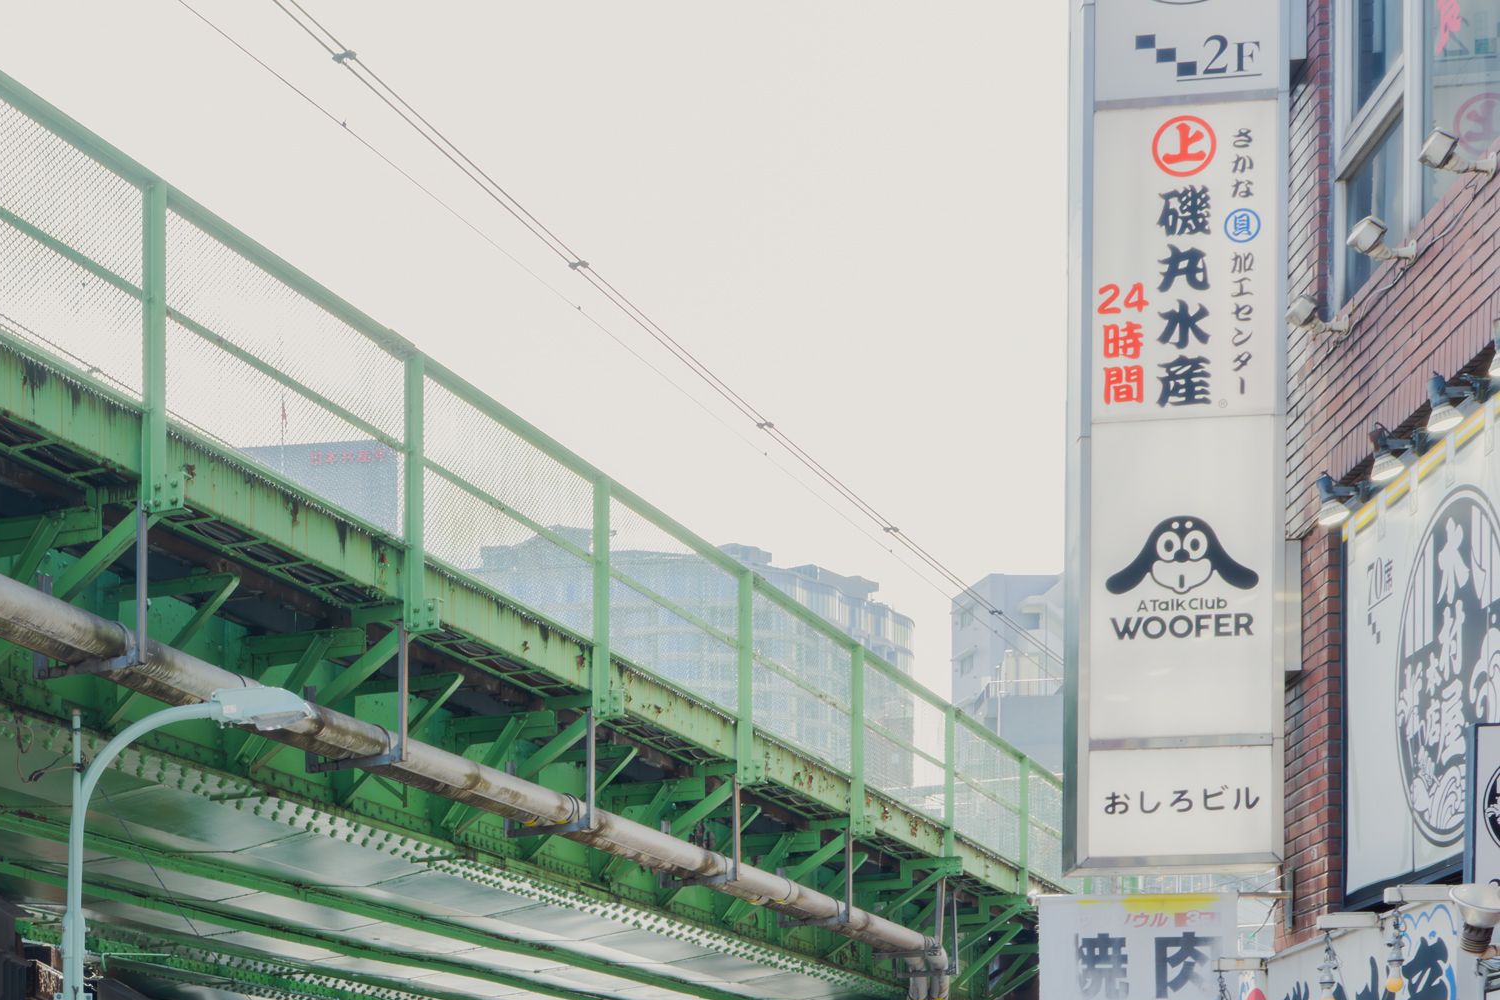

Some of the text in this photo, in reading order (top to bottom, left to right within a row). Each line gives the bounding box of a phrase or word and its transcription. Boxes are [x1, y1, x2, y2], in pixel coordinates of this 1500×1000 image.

[1203, 35, 1260, 74] 2F
[1156, 185, 1211, 407] 磯丸水産
[1150, 598, 1186, 611] Talk
[1189, 597, 1228, 611] Club
[1110, 612, 1254, 641] WOOFER
[1104, 785, 1260, 815] おしろビル
